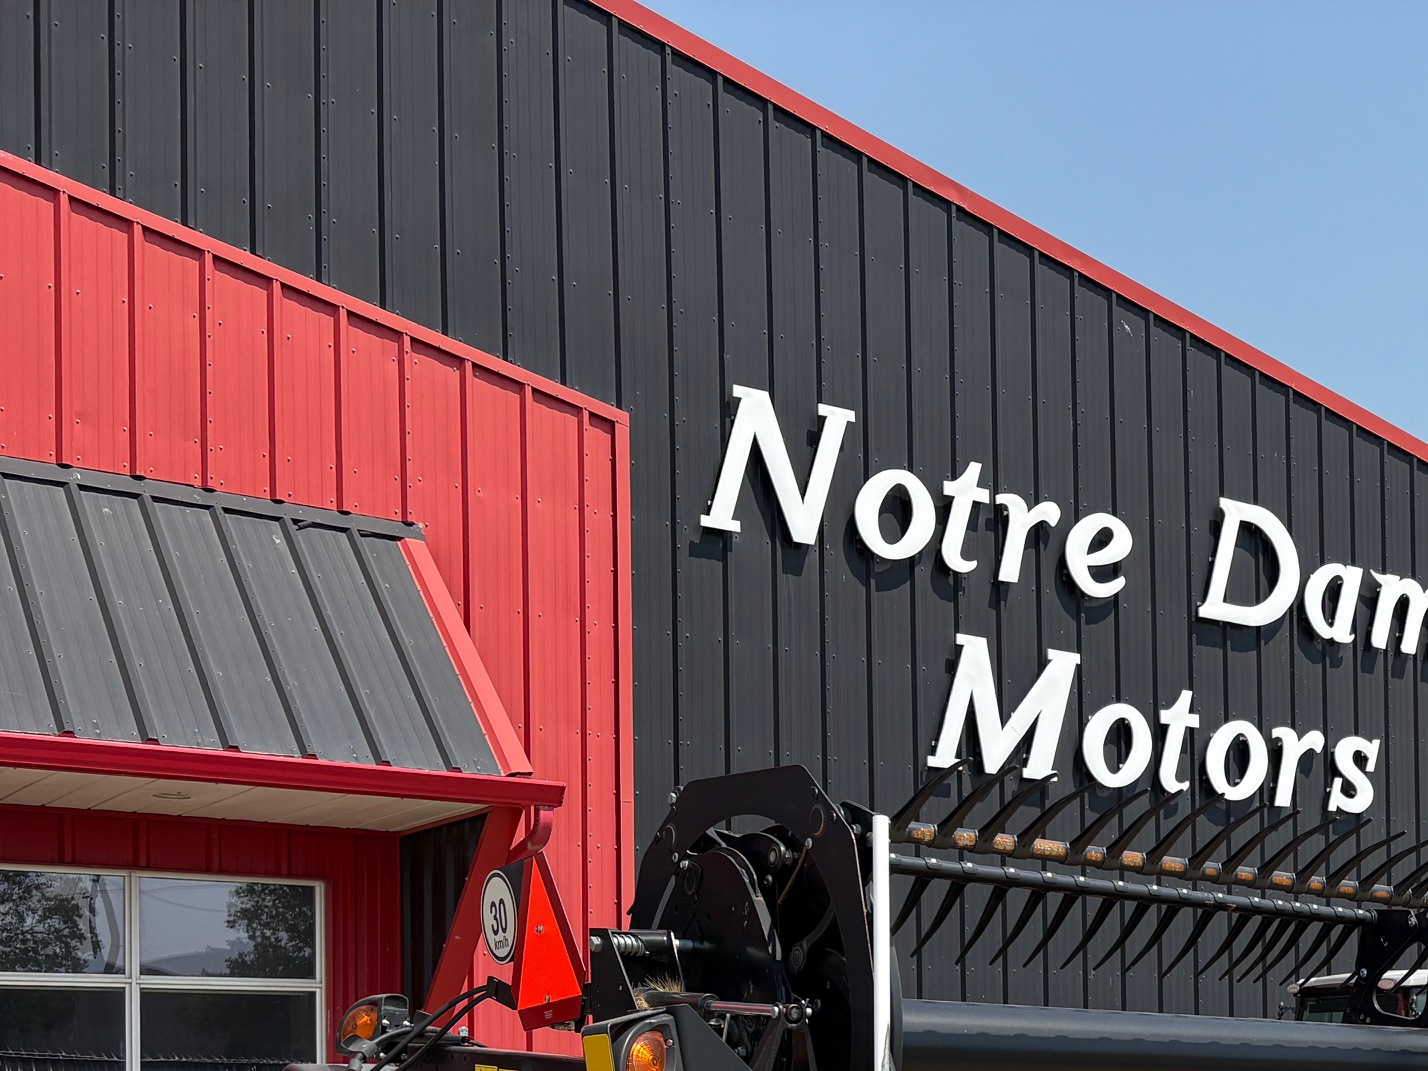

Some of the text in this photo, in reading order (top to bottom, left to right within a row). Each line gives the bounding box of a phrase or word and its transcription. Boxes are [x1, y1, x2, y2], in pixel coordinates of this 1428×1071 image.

[699, 384, 1134, 599] Notre
[926, 633, 1381, 814] Motors
[490, 898, 508, 937] 30
[494, 935, 509, 951] km/h
